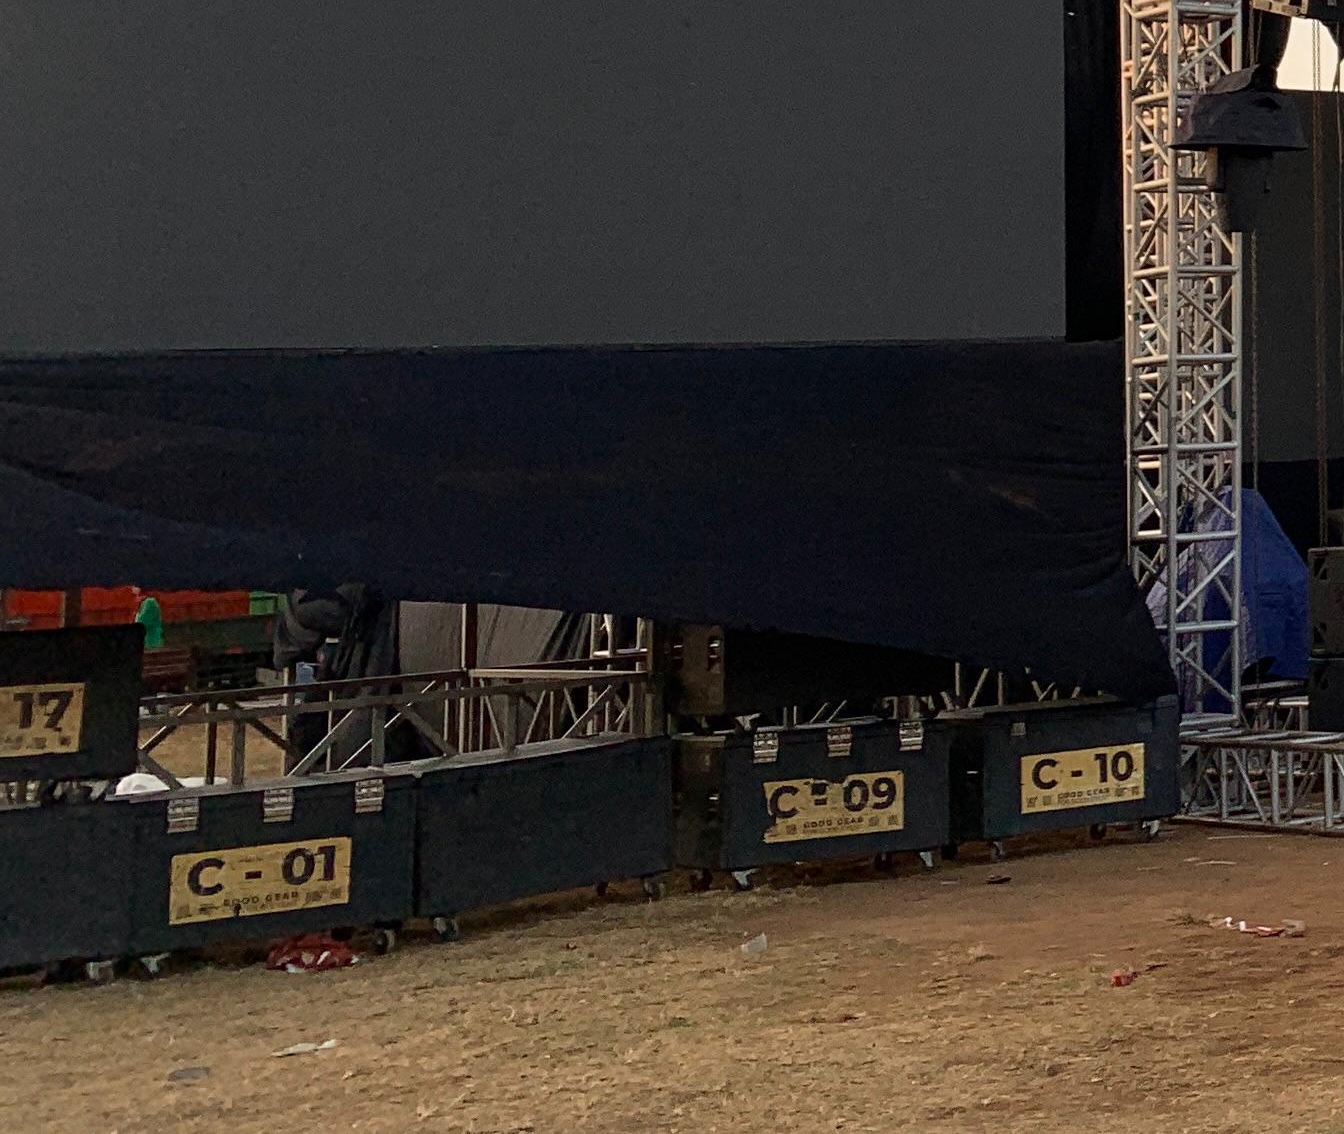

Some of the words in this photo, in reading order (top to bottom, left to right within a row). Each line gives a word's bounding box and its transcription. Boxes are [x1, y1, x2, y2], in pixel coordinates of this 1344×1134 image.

[13, 690, 74, 729] 17
[1094, 750, 1134, 783] 10
[843, 777, 896, 812] 09
[281, 845, 336, 885] 01
